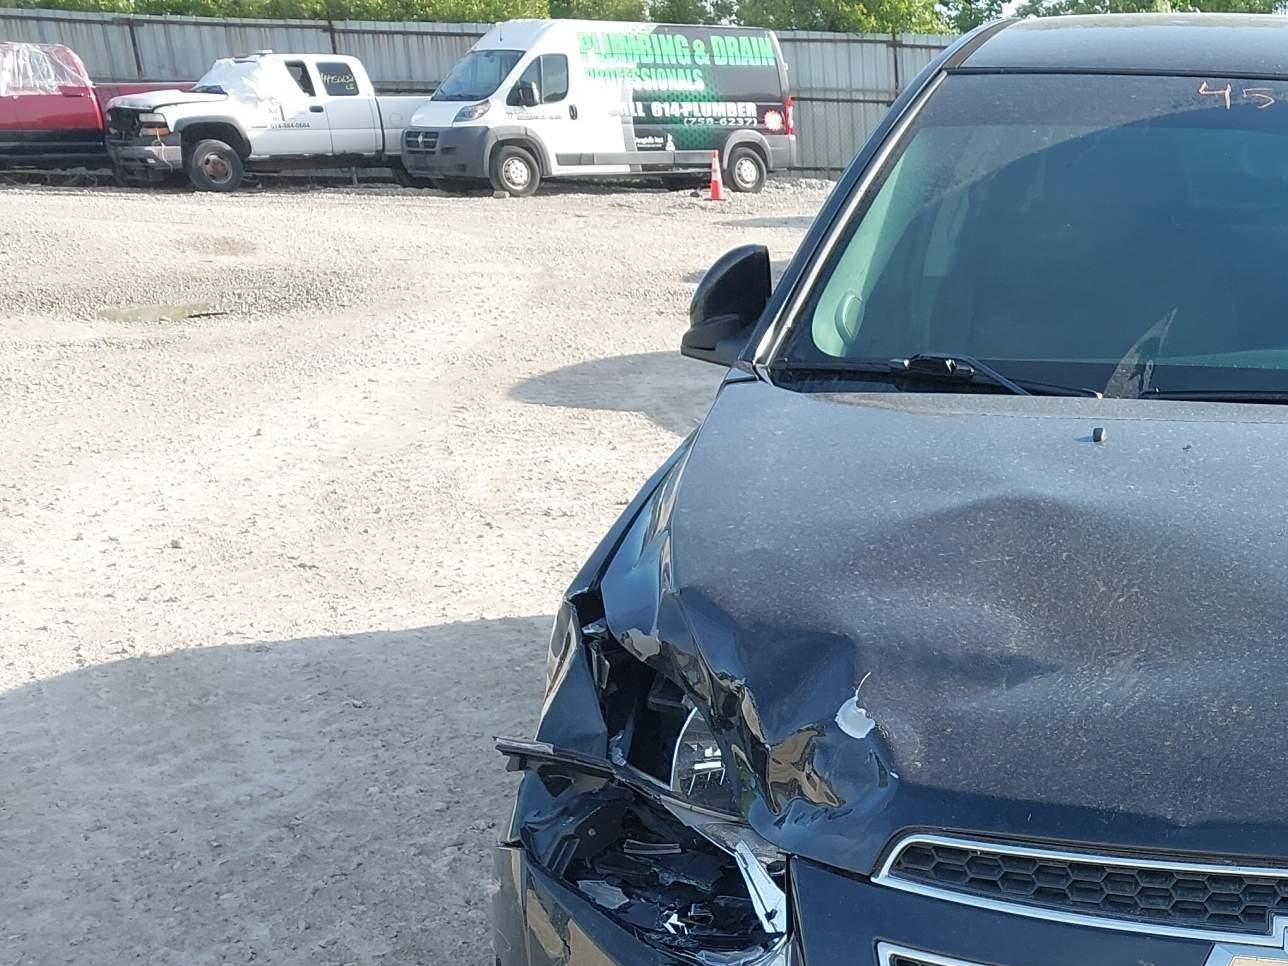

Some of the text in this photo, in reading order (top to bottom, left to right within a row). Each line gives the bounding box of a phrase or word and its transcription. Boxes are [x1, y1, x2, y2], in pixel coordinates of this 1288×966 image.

[577, 32, 776, 66] PLUMBING & DRAIN
[584, 67, 705, 91] PROFESSIONALS
